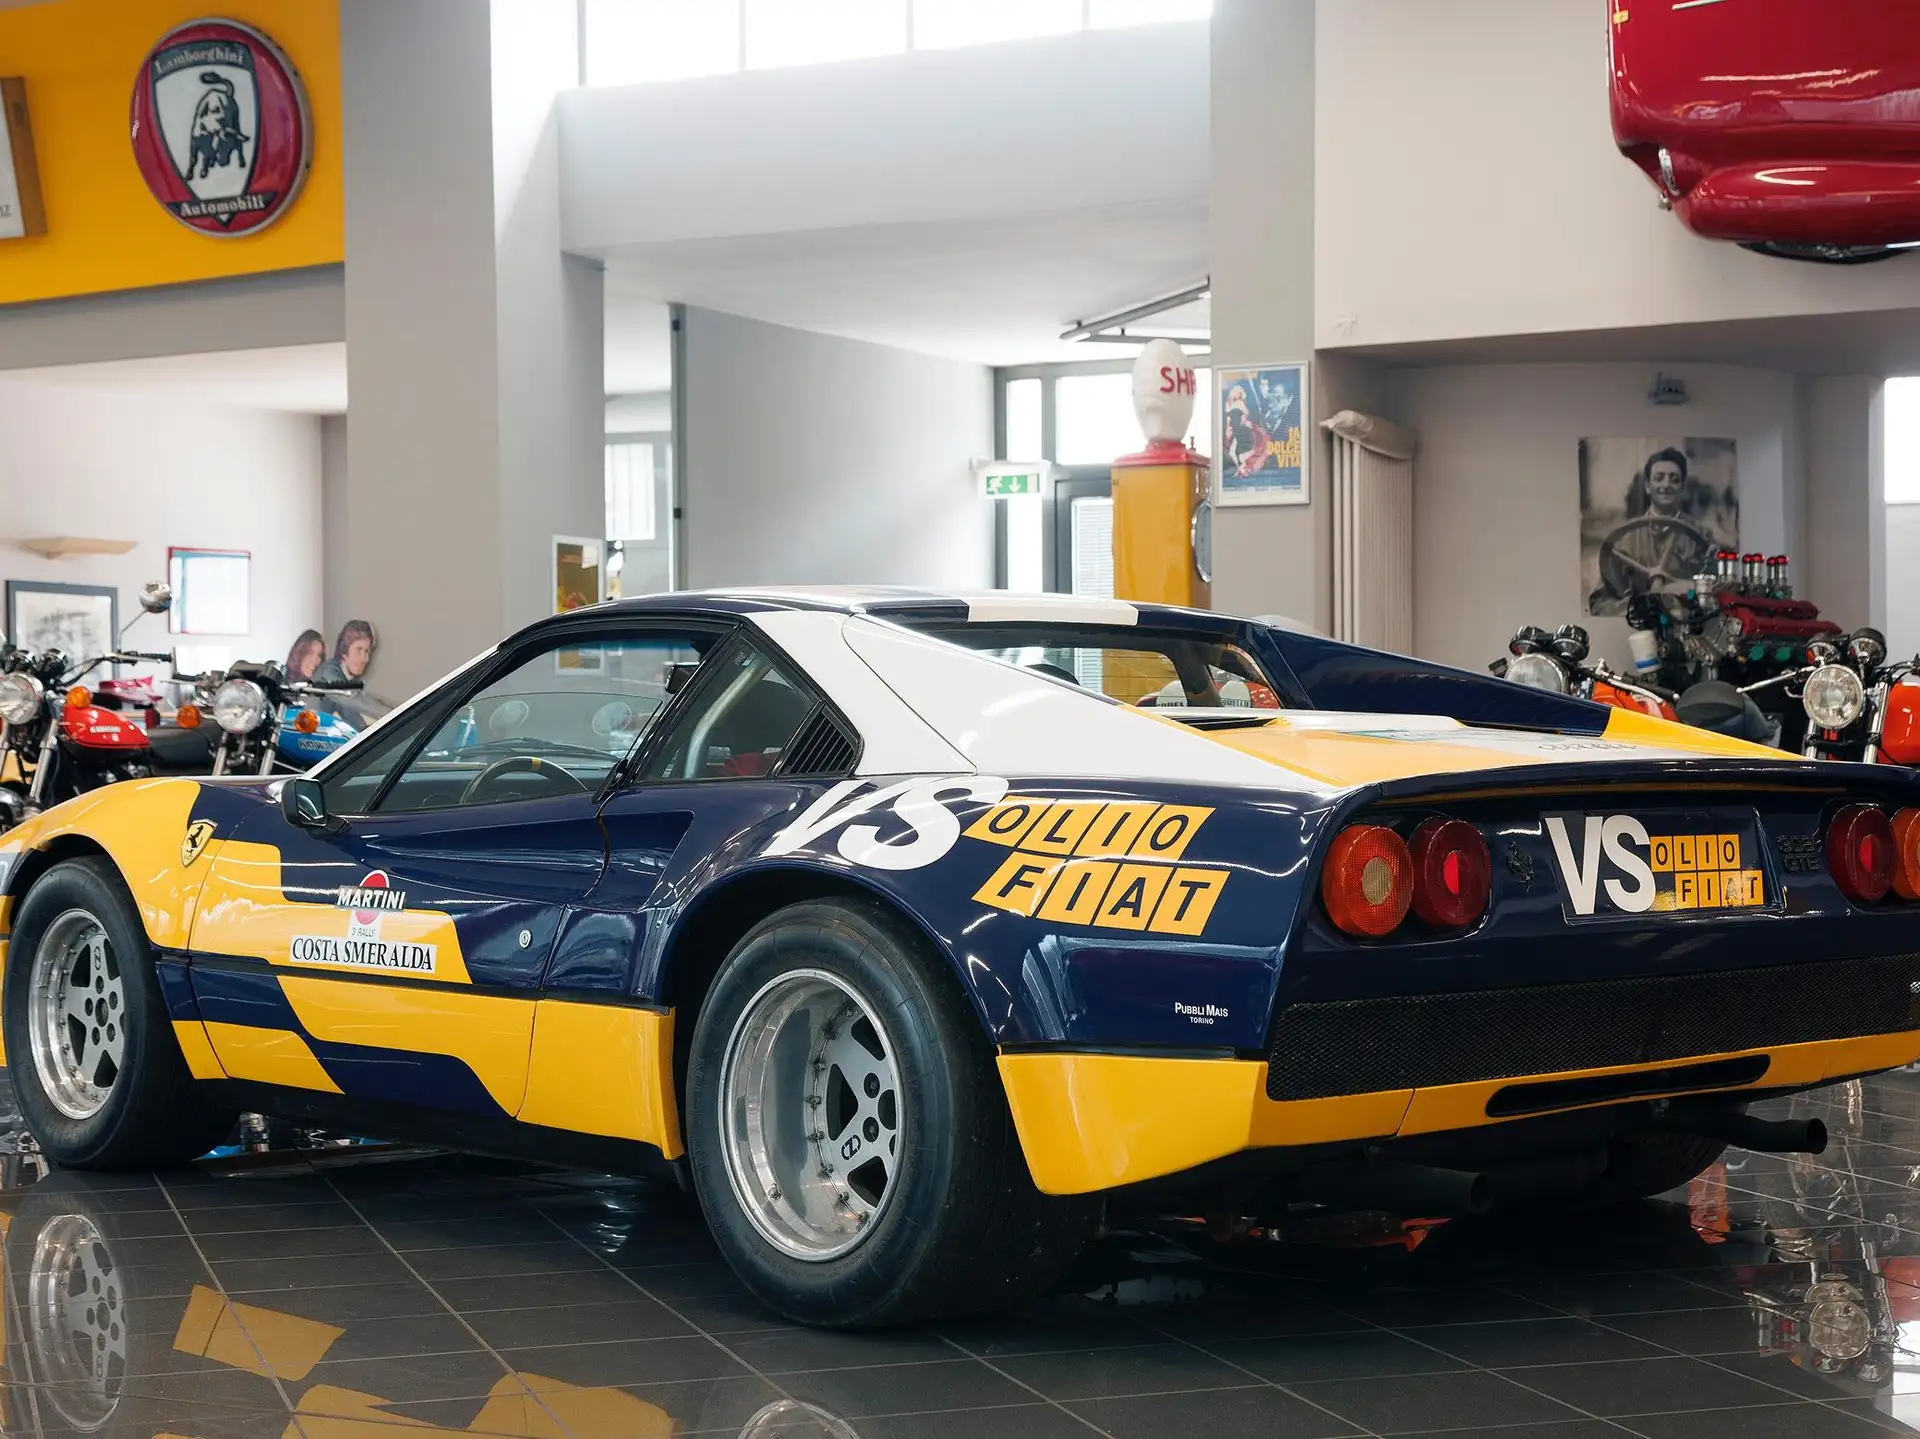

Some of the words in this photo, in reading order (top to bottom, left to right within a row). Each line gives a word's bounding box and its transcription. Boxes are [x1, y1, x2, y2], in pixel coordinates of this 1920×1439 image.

[154, 46, 245, 73] Lamborghini
[757, 776, 1010, 871] VS
[987, 804, 1190, 851] OLIO
[1544, 814, 1656, 915] VS
[1655, 840, 1735, 866] OLIO
[337, 888, 406, 910] MARTINI
[997, 864, 1212, 922] FIAT
[1681, 876, 1758, 906] FIAT
[358, 927, 376, 938] RALLY
[292, 937, 340, 963] COSTA
[342, 940, 433, 970] SMERALDA
[1190, 1016, 1214, 1025] TORINO
